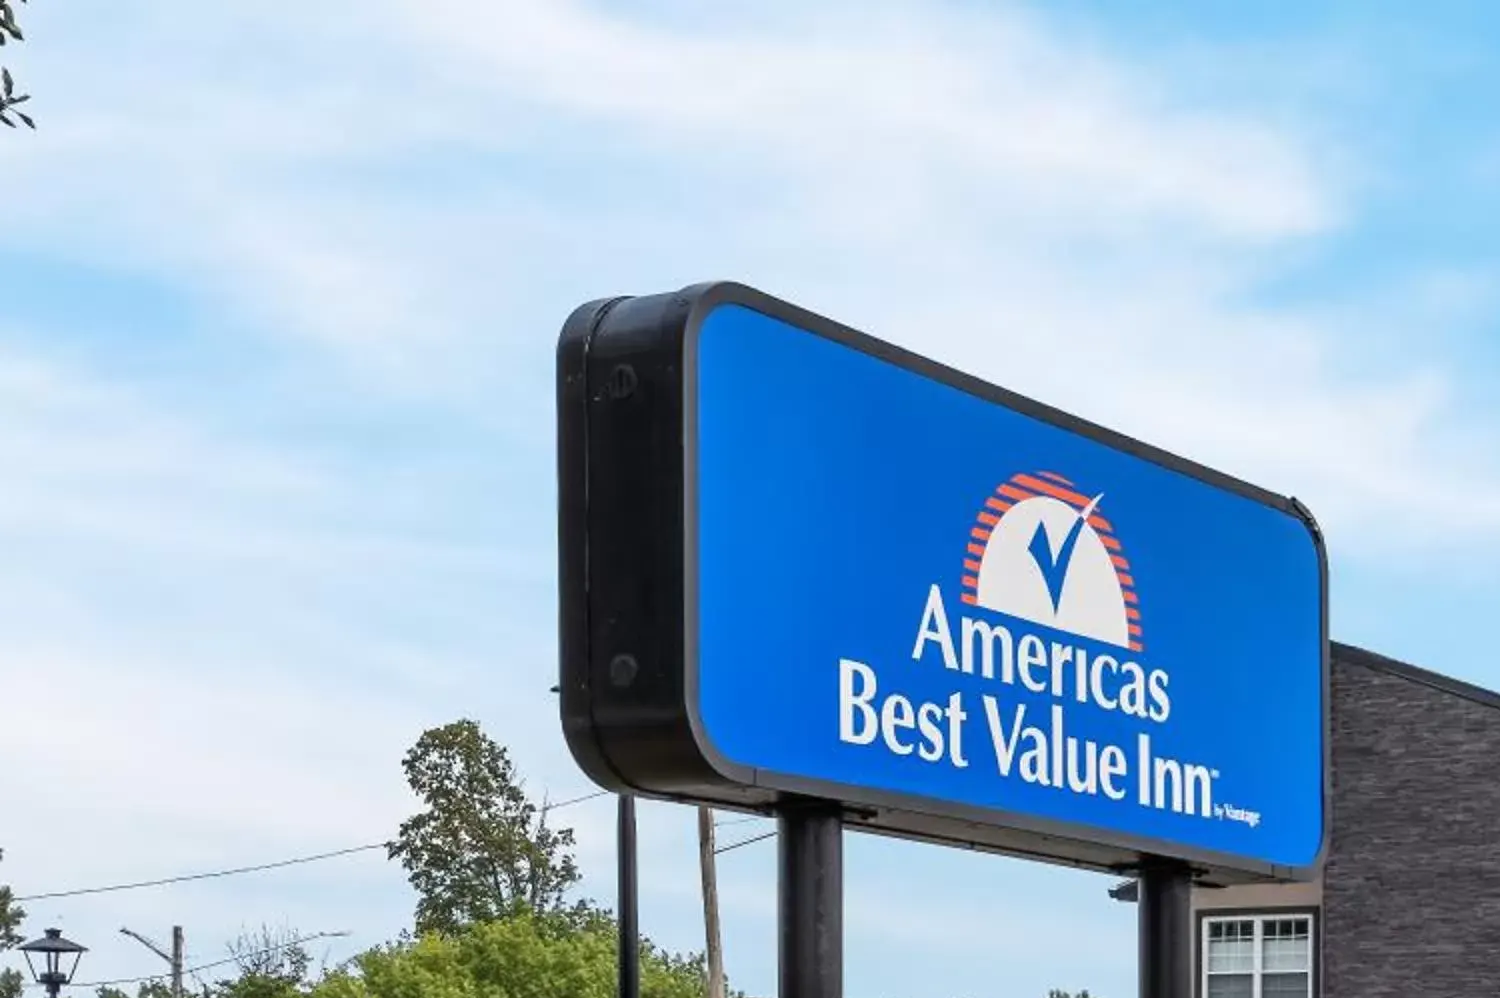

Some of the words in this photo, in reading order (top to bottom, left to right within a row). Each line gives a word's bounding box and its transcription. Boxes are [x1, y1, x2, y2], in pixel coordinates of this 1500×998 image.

[912, 583, 1170, 722] Americas
[839, 659, 968, 768] Best
[983, 695, 1127, 800] Value
[1138, 733, 1212, 818] Inn
